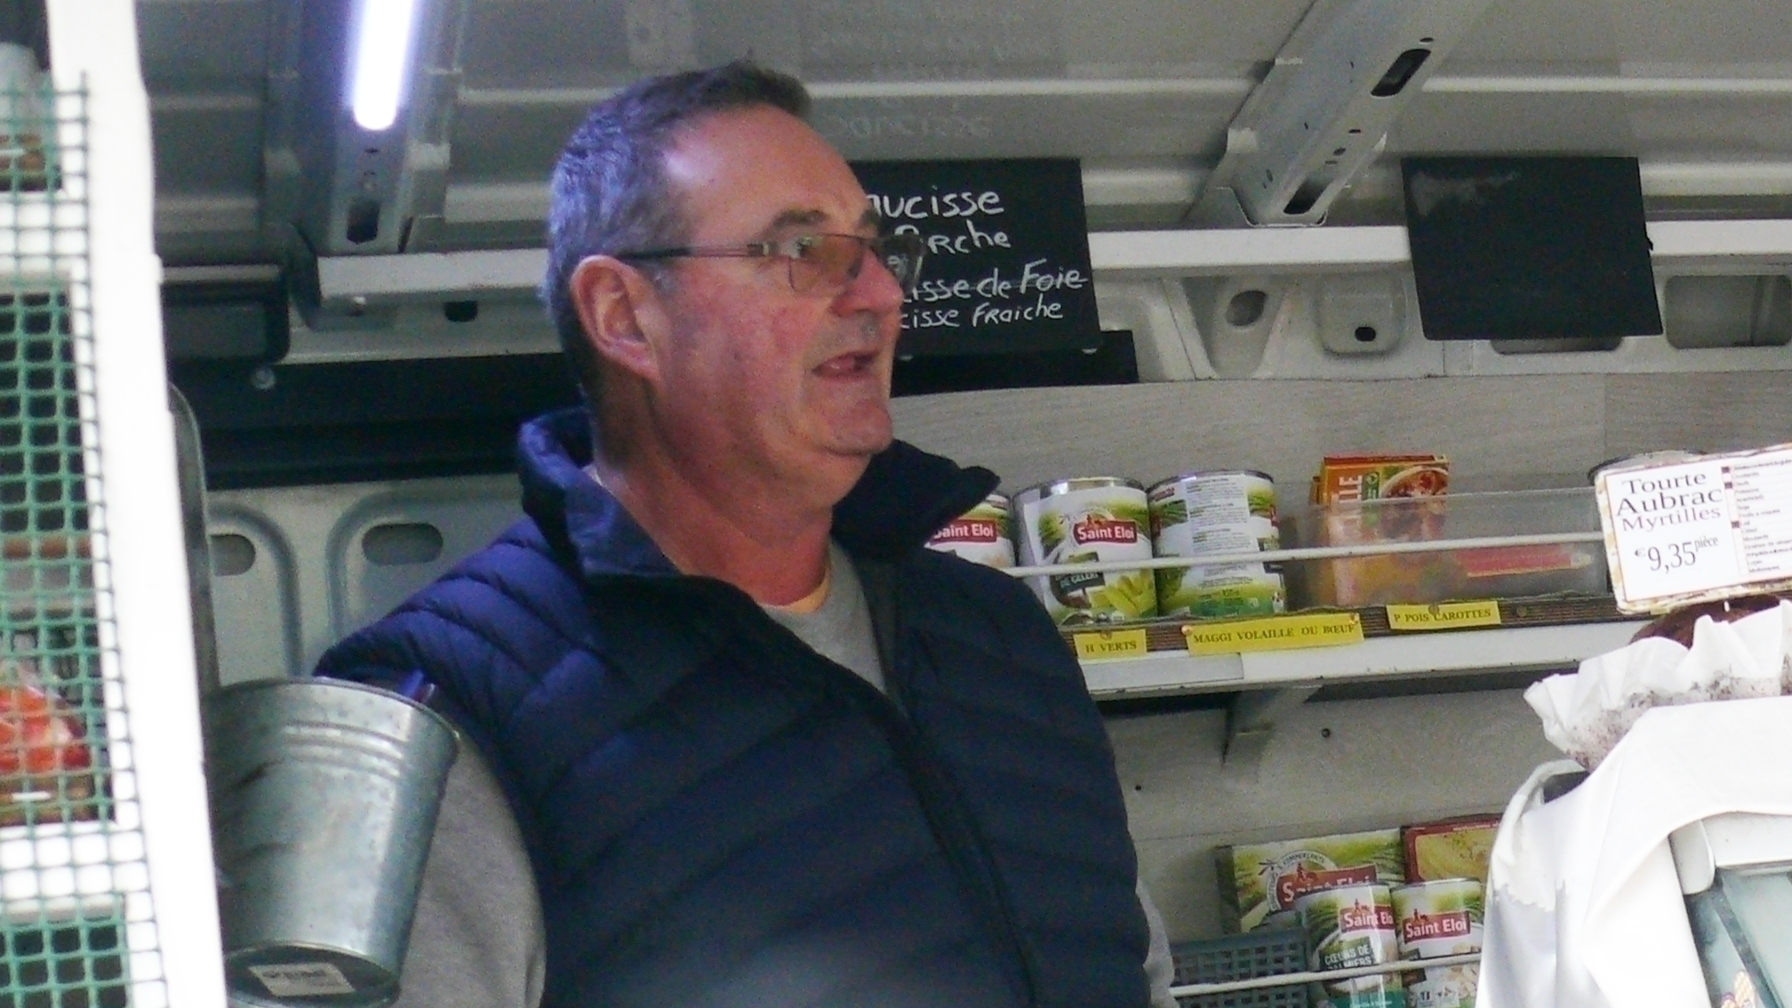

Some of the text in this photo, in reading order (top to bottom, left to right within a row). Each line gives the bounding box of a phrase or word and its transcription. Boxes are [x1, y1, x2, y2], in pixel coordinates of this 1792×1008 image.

[866, 184, 1005, 220] aucisse
[976, 267, 1013, 299] de
[1020, 257, 1089, 294] Foie
[1621, 472, 1708, 495] Tourte
[1616, 488, 1724, 517] Aubrac
[1621, 506, 1722, 533] Myrtilles
[971, 523, 995, 538] Eloi
[1075, 524, 1137, 542] Saint Eloi
[1405, 611, 1430, 623] POIS
[1433, 608, 1492, 622] CAROTTES
[1193, 630, 1233, 643] MAGGI
[1237, 627, 1295, 642] VOLAILLE
[1300, 625, 1318, 636] OU
[1100, 640, 1137, 653] VERTS
[1344, 910, 1378, 929] Saint
[1405, 915, 1467, 939] Saint Eloi
